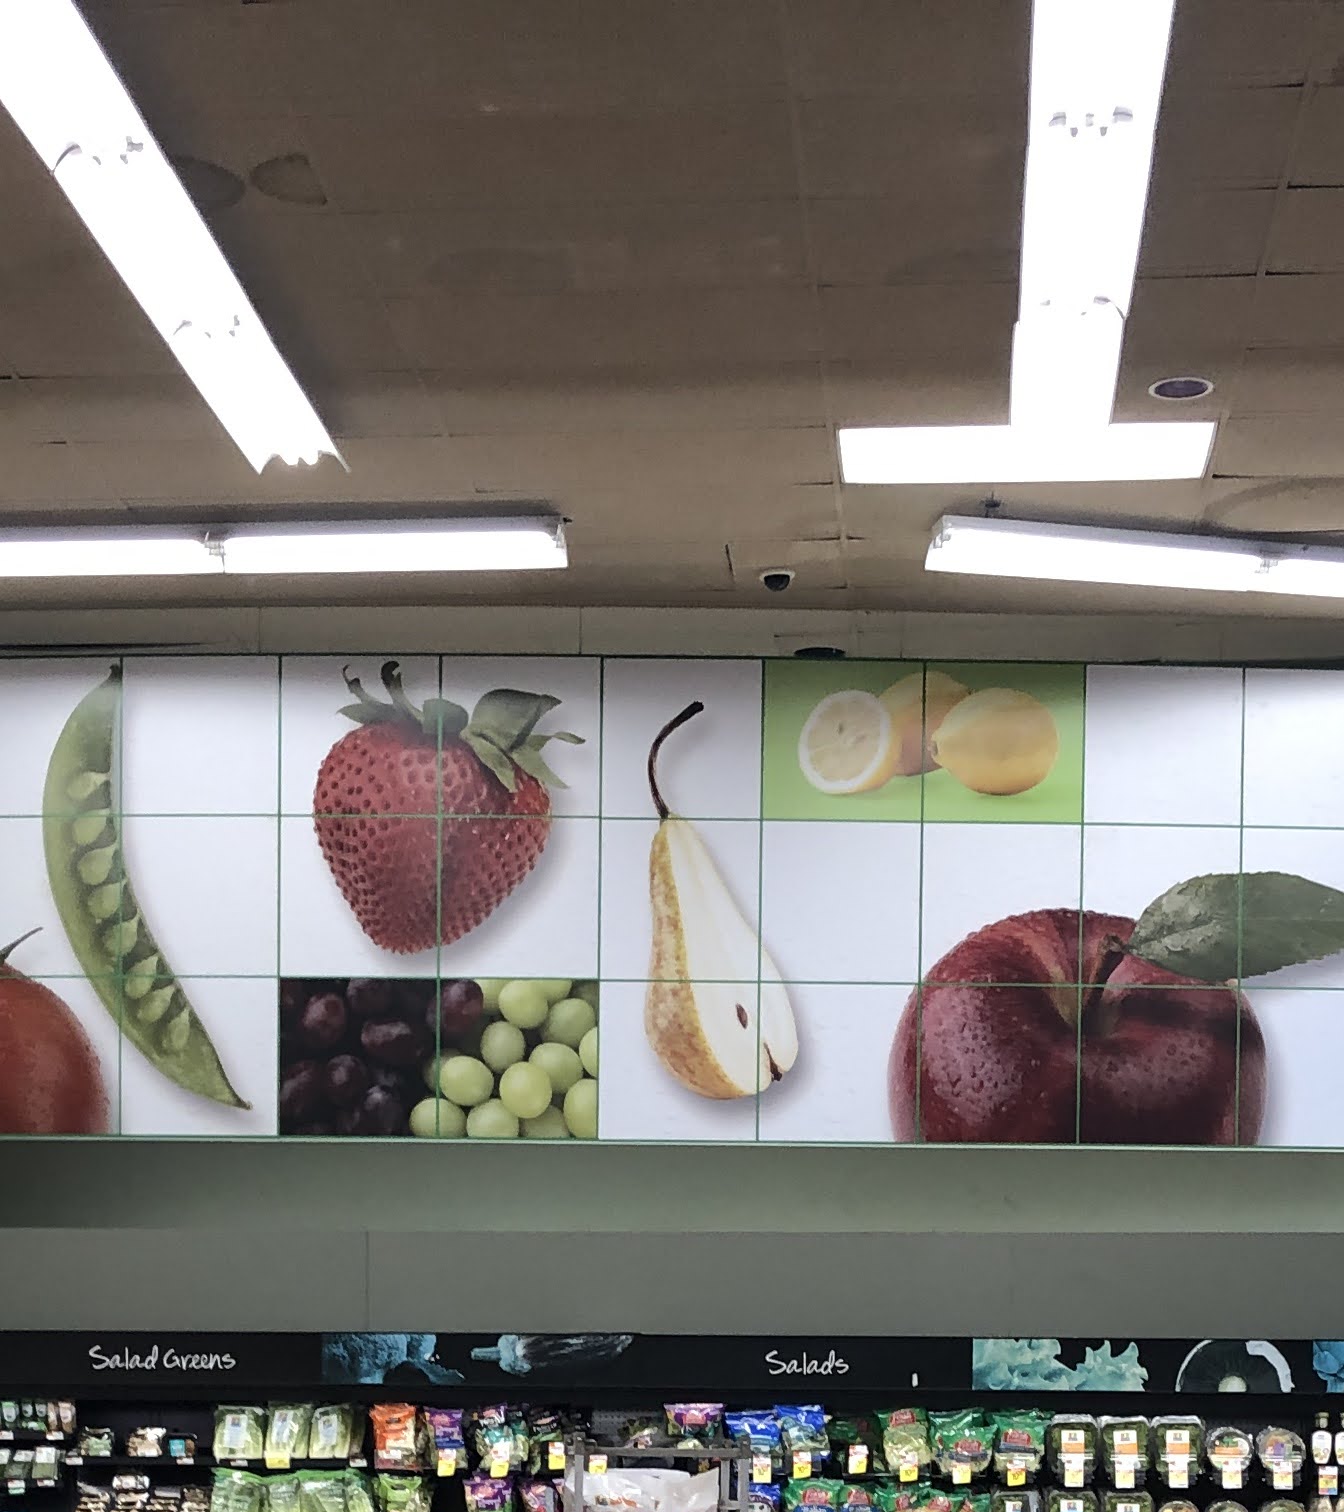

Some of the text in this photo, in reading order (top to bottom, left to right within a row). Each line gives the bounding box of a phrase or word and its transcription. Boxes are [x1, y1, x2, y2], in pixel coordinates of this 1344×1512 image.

[88, 1344, 236, 1371] Salad Greens
[765, 1349, 849, 1375] Salads
